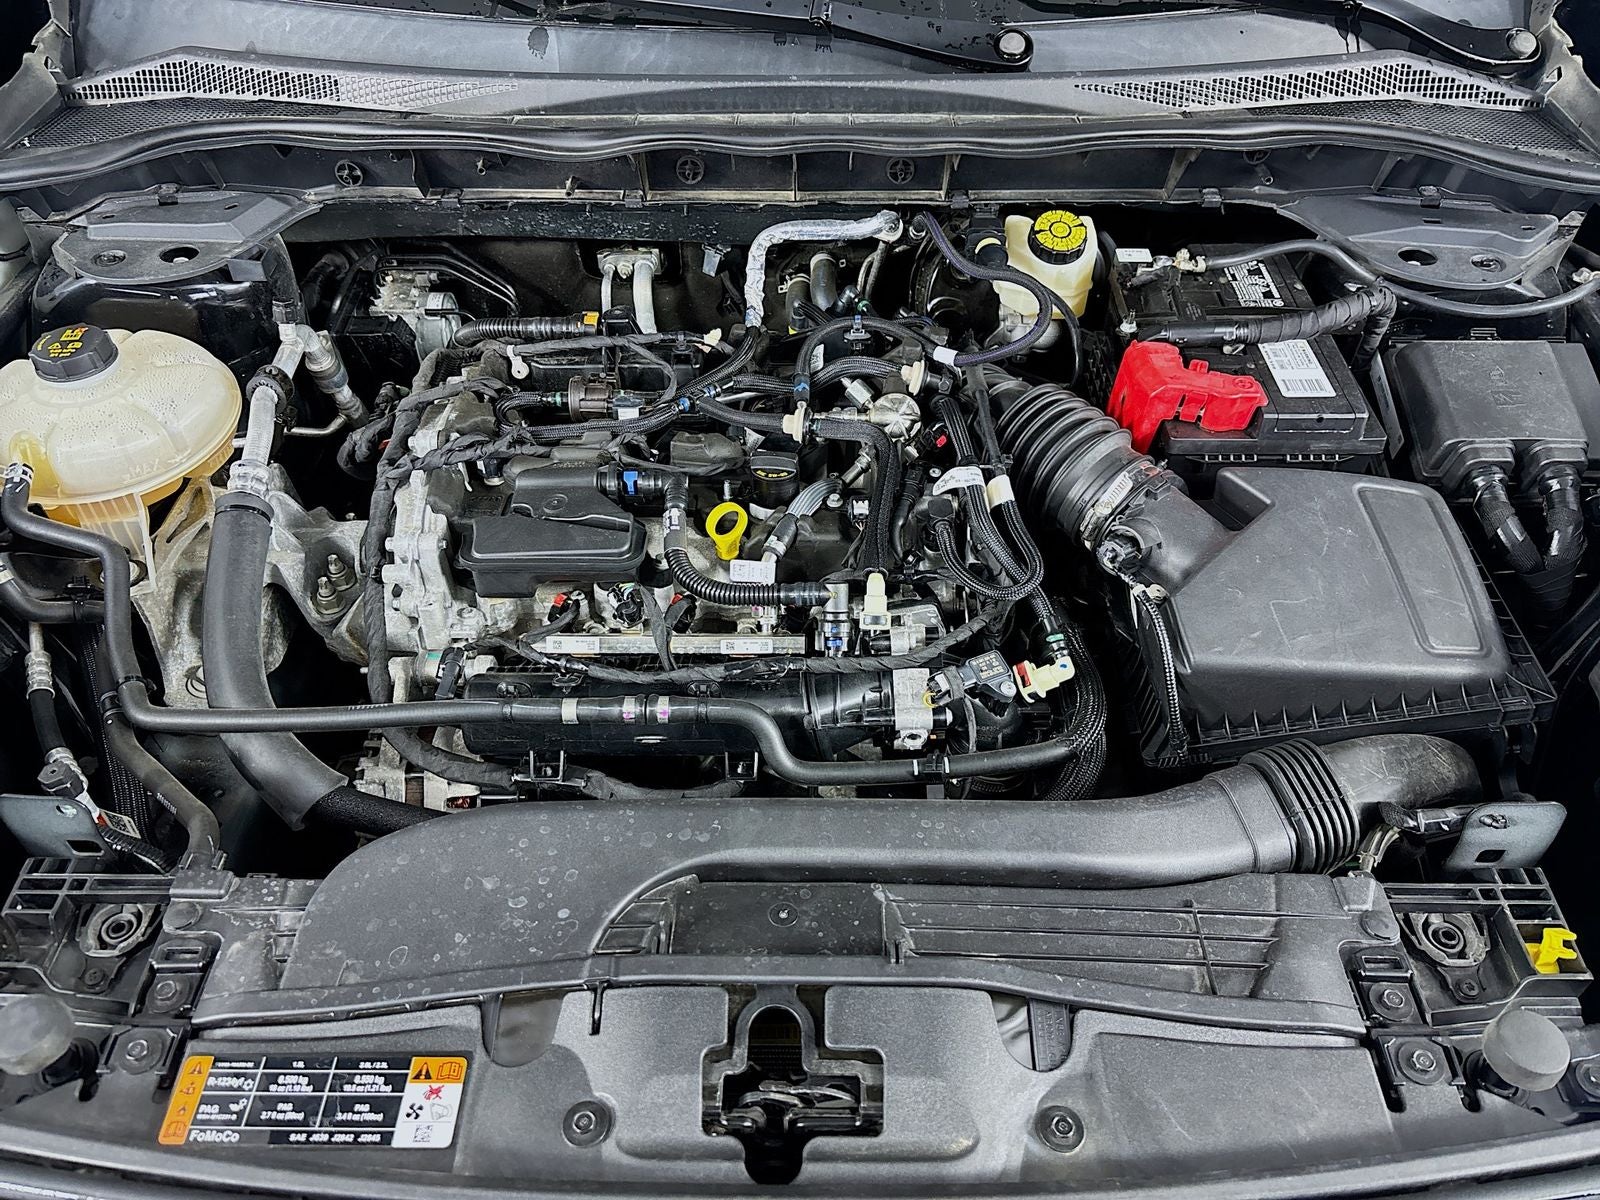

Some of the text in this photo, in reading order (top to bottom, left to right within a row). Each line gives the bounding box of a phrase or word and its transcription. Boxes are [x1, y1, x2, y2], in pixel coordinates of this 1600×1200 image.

[198, 1104, 220, 1114] PAG
[188, 1130, 240, 1143] FoMoCo
[288, 1133, 308, 1142] SAE
